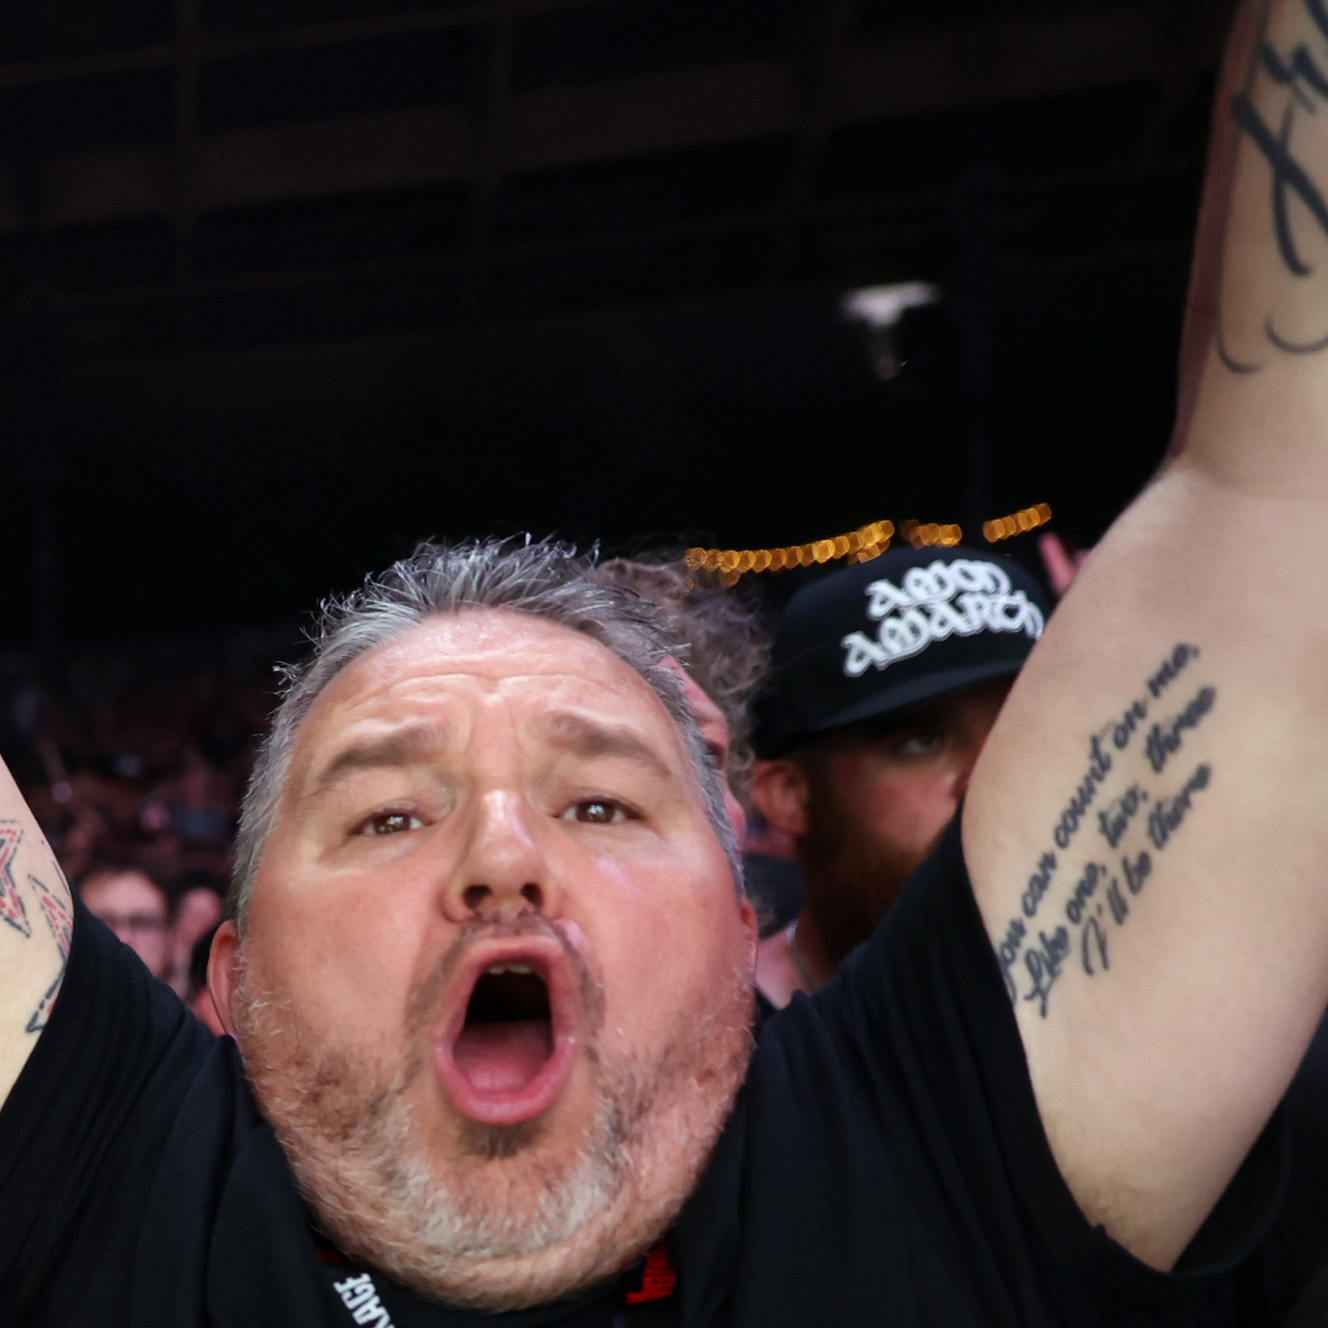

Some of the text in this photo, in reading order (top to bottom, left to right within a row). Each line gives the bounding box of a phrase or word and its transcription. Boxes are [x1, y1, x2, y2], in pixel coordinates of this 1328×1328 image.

[1146, 685, 1218, 774] three
[1021, 851, 1058, 918] can
[1052, 733, 1114, 850] count
[1113, 700, 1147, 751] on
[1122, 850, 1152, 896] be
[1147, 762, 1212, 850] there
